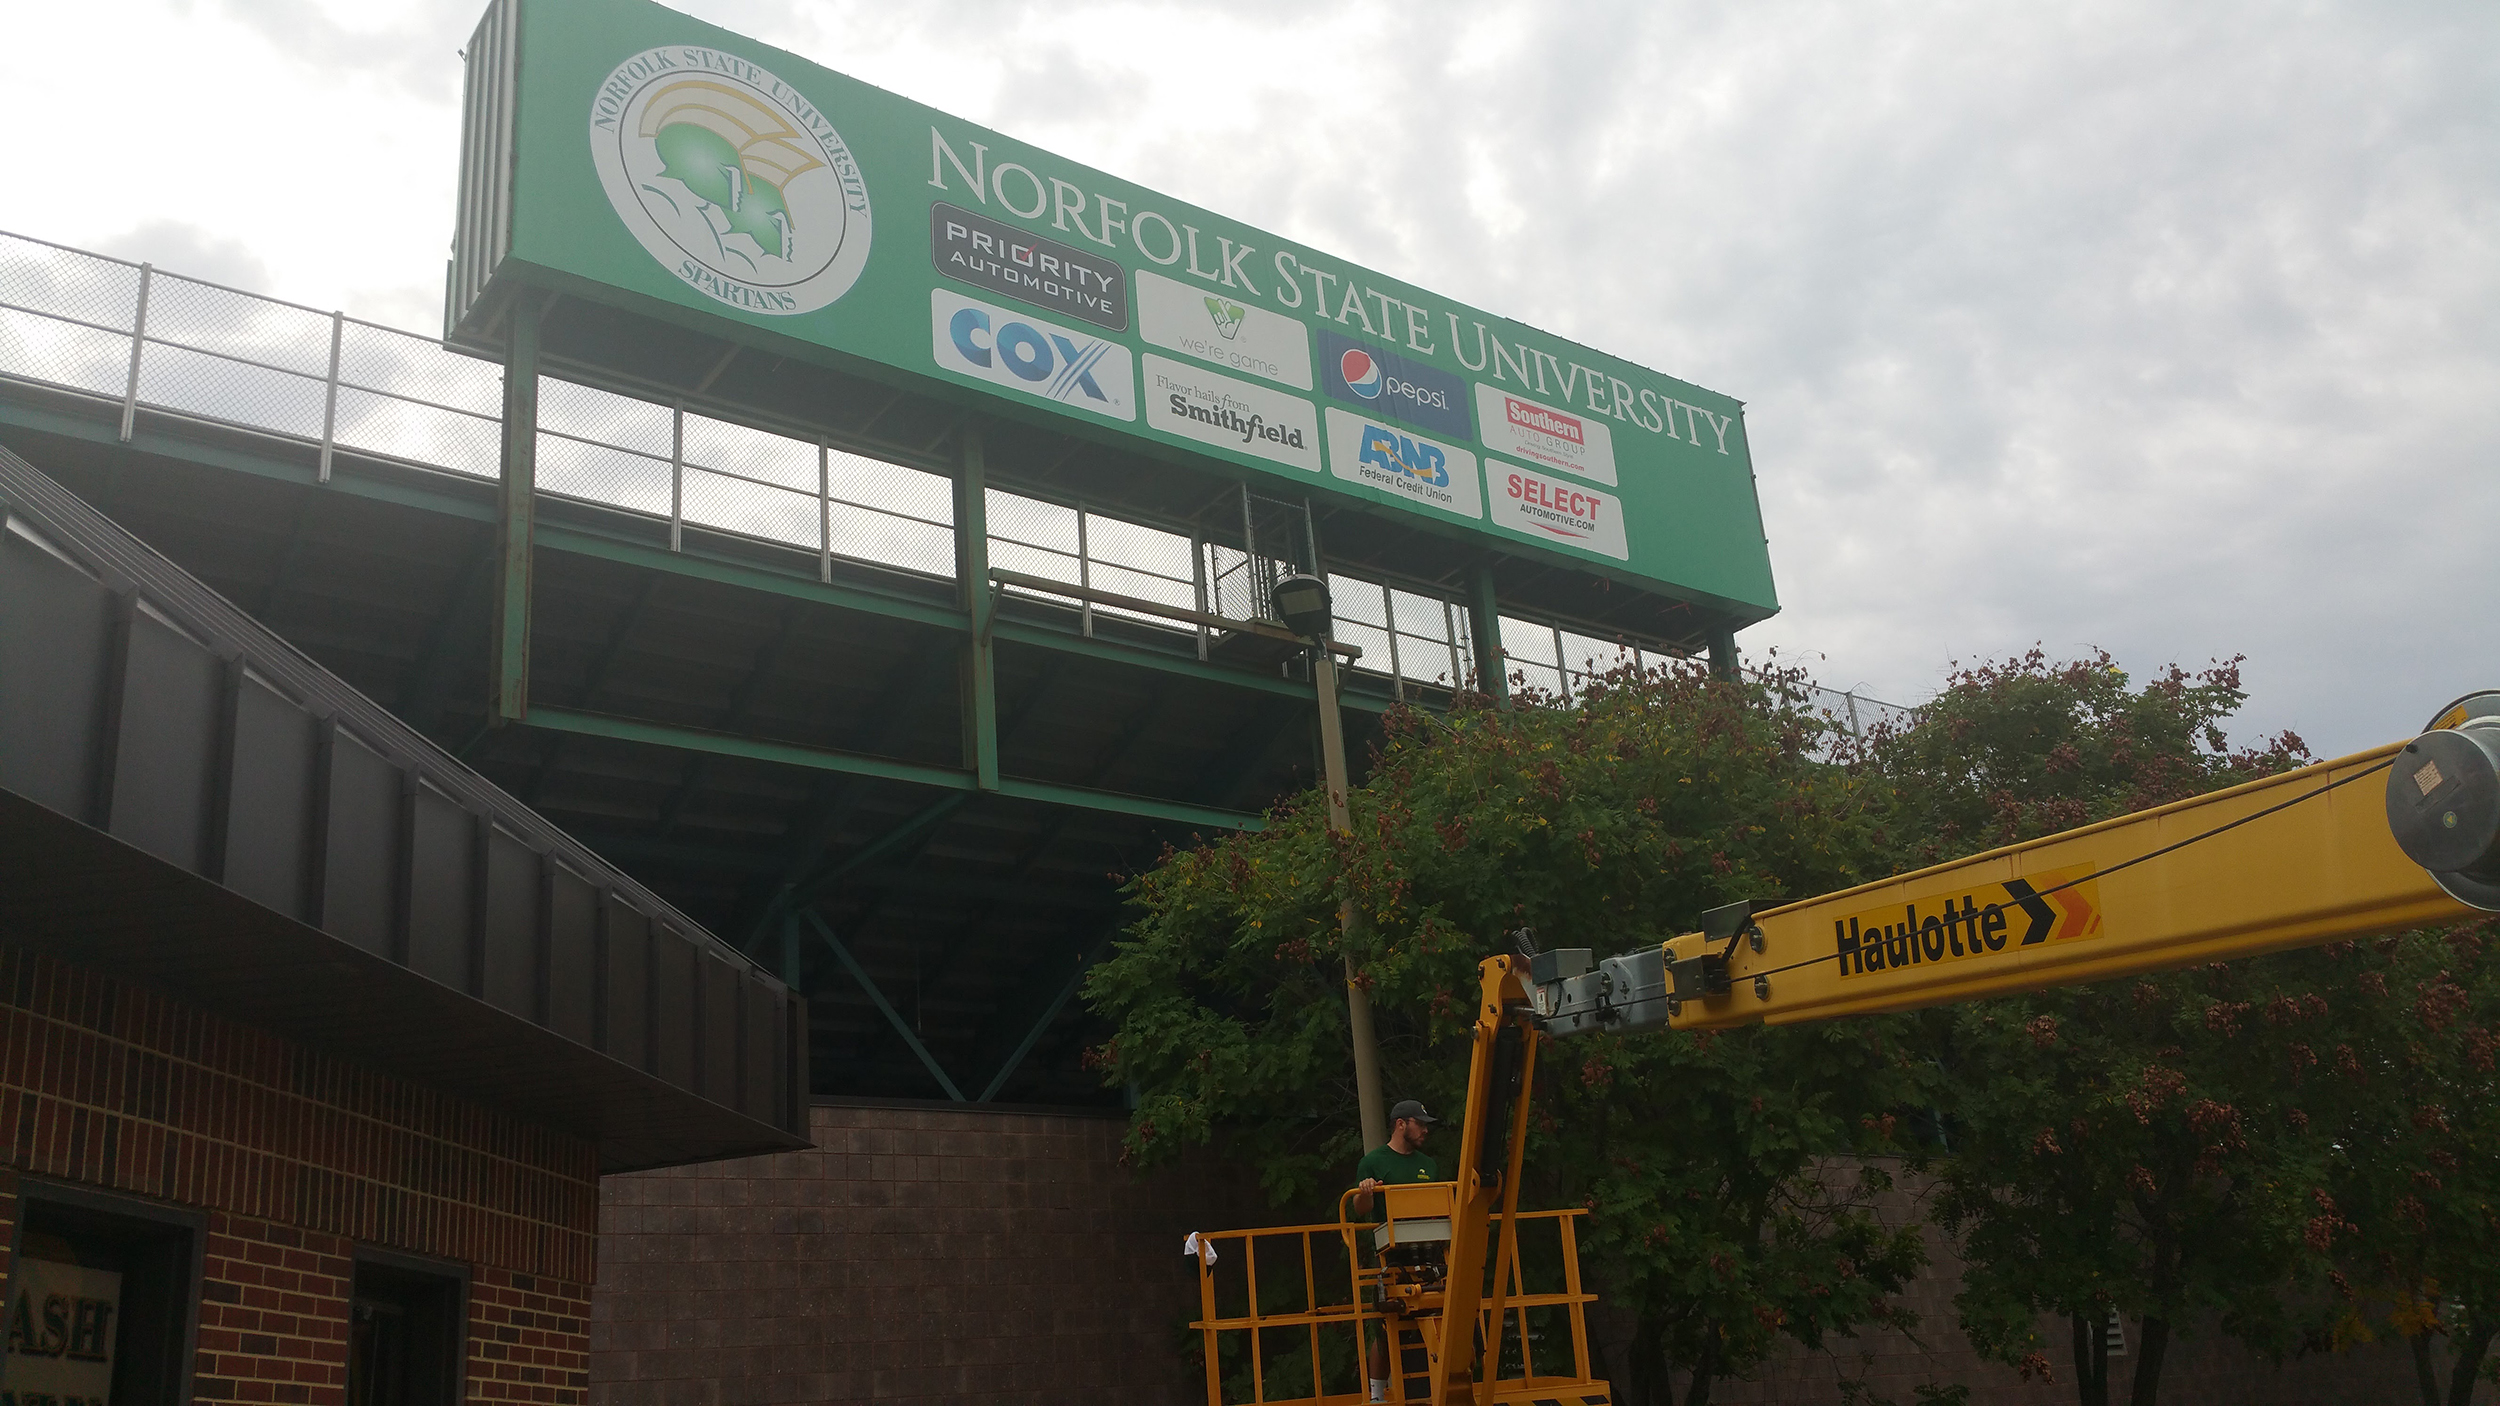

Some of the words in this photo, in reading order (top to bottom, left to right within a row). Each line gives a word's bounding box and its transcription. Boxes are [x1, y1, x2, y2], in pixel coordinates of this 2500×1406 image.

[594, 49, 677, 133] NORFOLK
[683, 49, 761, 86] STATE
[770, 80, 868, 219] UNIVERSITY
[946, 220, 1114, 293] PRIORITY
[678, 260, 797, 311] SPARTANS
[928, 126, 1261, 297] NORFOLK
[1274, 250, 1435, 356] STATE
[1445, 311, 1732, 456] UNIVERSITY
[950, 251, 1114, 315] AUTOMOTIVE
[949, 307, 1113, 403] COX
[1179, 335, 1224, 360] we're
[1229, 351, 1279, 376] game
[1156, 374, 1193, 396] Flavor
[1194, 385, 1221, 405] hails
[1220, 394, 1250, 412] from
[1386, 376, 1447, 410] pepsi
[1169, 394, 1305, 450] Smithfield
[1509, 401, 1580, 440] Southern
[1509, 425, 1540, 443] AUTO
[1546, 436, 1586, 456] GROUP
[1359, 424, 1450, 488] ABNB
[1516, 446, 1585, 472] drivingsouthern.com
[1359, 465, 1394, 486] Federal
[1396, 477, 1424, 496] Credit
[1425, 486, 1453, 504] Union
[1507, 473, 1601, 521] SELECT
[1520, 503, 1595, 532] AUTOMOTIVE.COM
[1835, 895, 2008, 977] Haulotte
